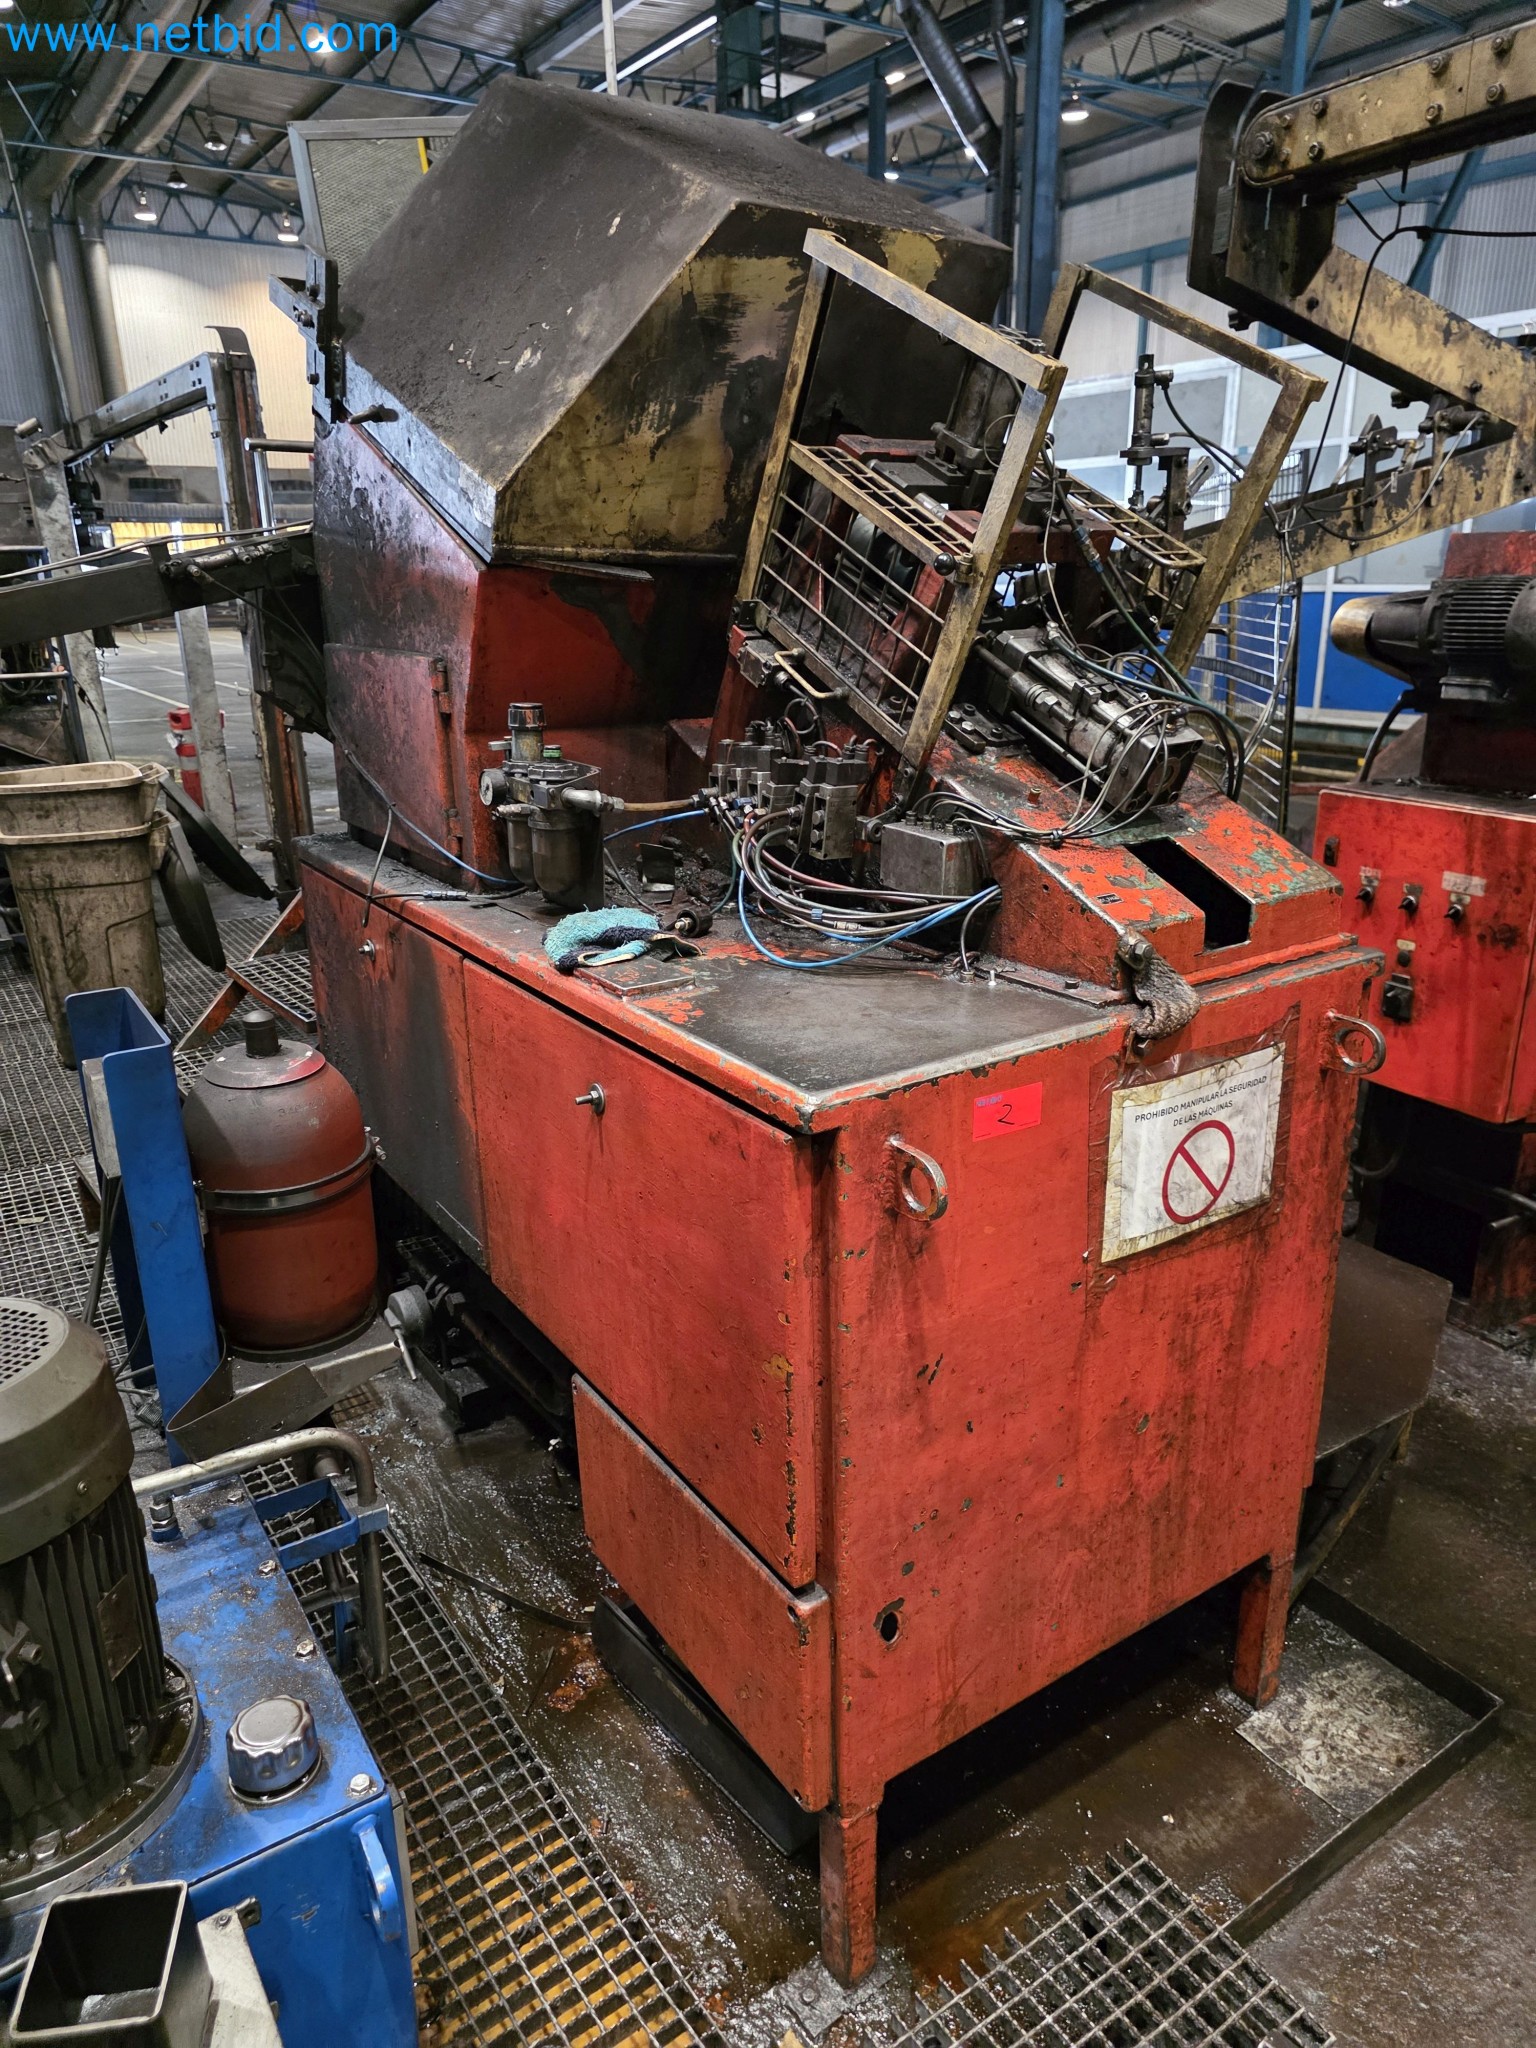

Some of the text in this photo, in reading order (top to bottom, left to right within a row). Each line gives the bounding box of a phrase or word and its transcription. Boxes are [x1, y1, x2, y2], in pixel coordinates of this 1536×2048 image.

[1134, 1075, 1267, 1123] PROHIBIDO MANIPULAR LA SEGURIDAD
[997, 1104, 1015, 1125] 2
[1173, 1117, 1183, 1127] DE
[1184, 1112, 1197, 1123] LAS
